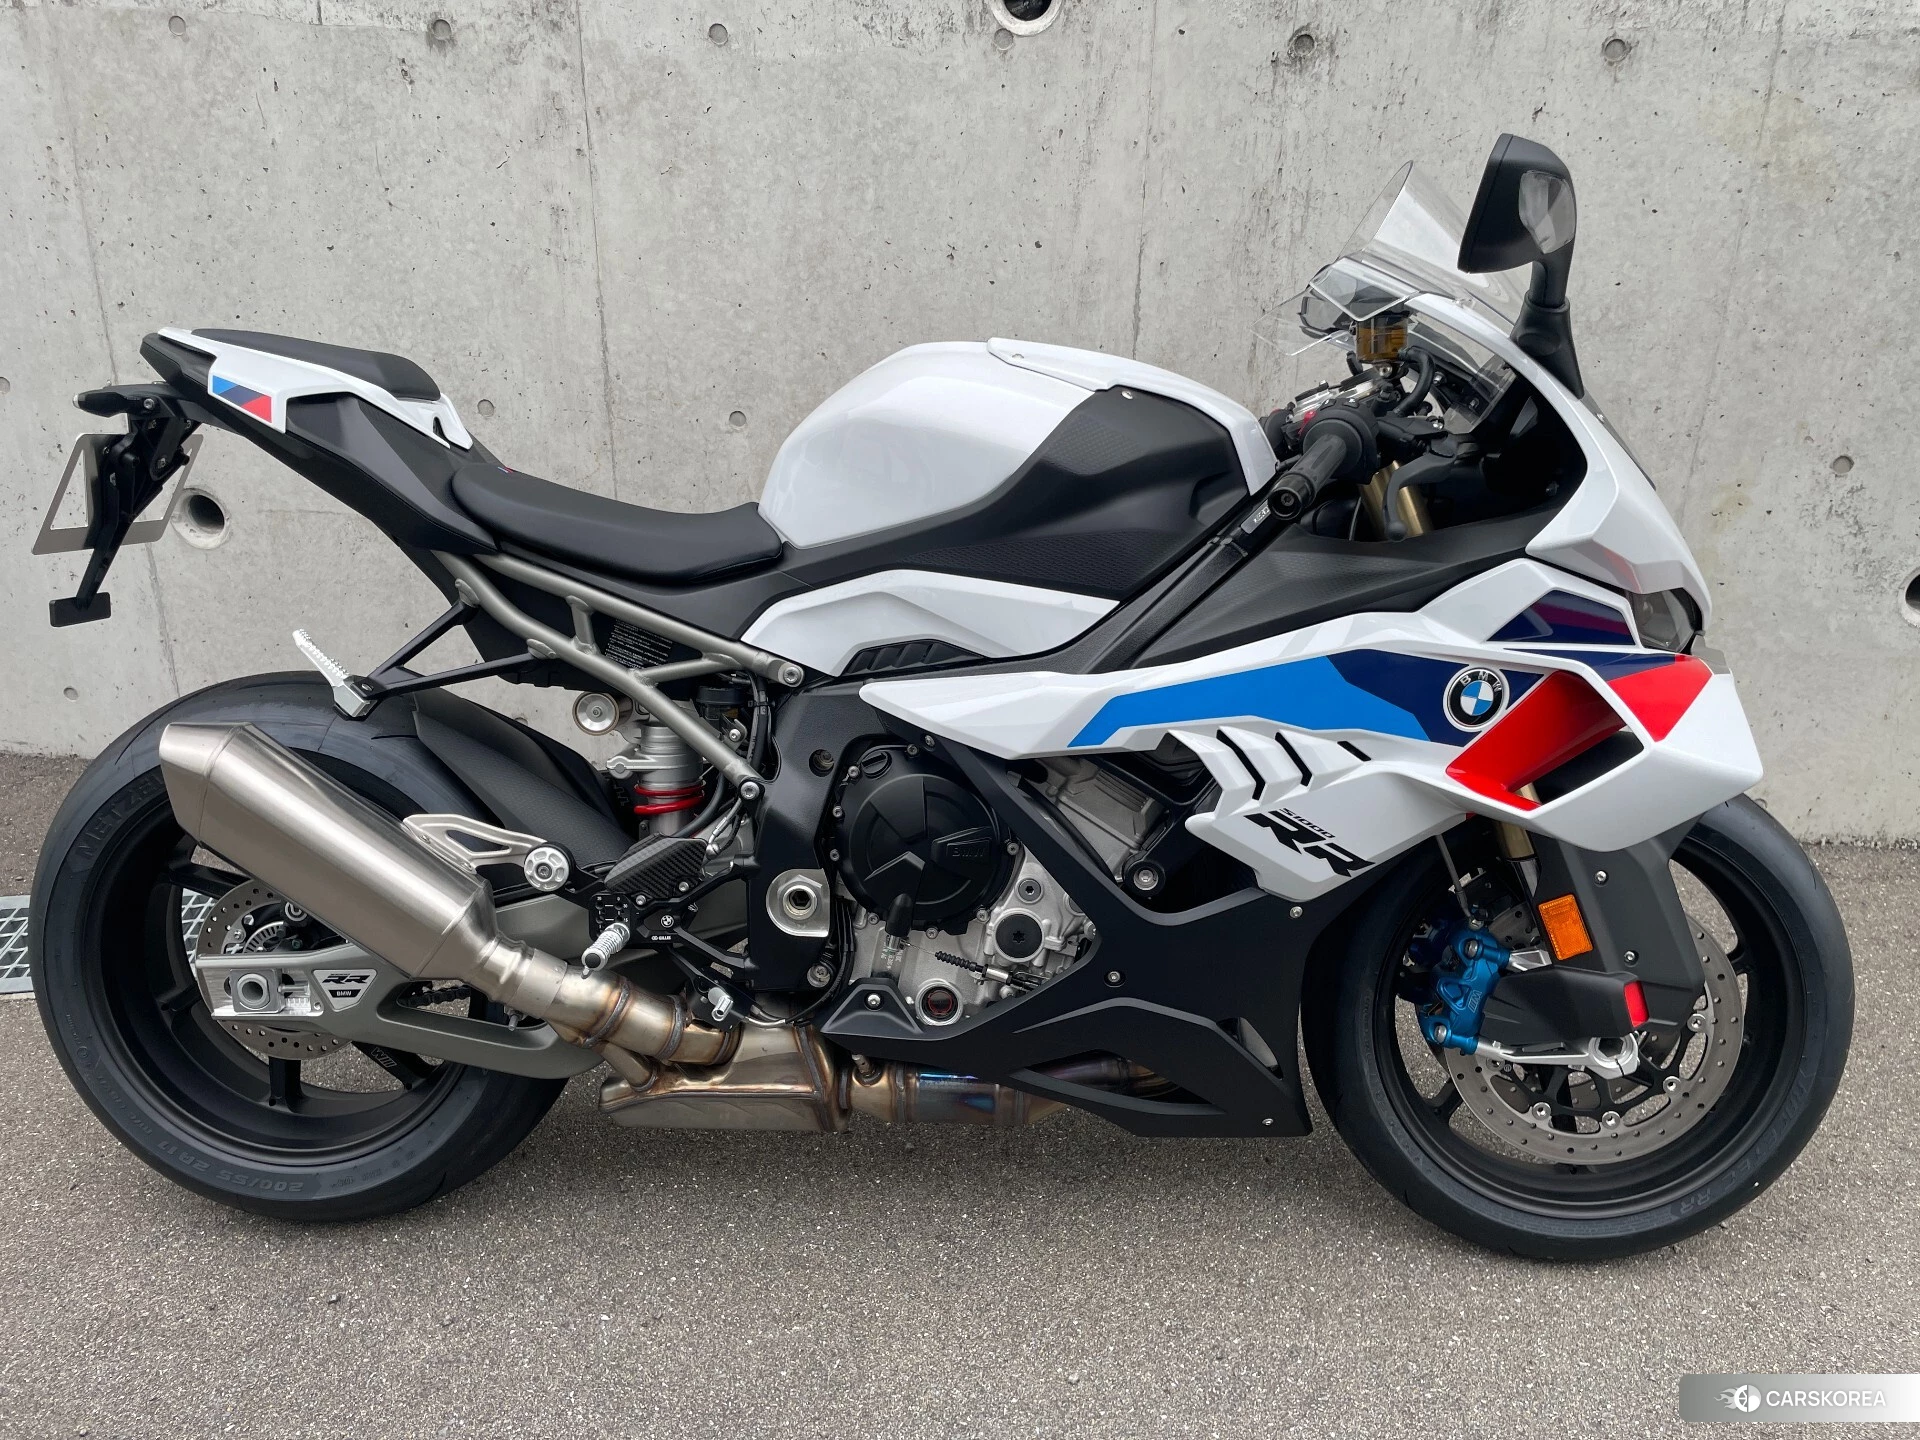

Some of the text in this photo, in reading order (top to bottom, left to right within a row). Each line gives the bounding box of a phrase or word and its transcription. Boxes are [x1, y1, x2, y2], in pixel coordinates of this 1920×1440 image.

[1460, 670, 1502, 692] BMW
[1279, 807, 1336, 839] S1000
[1243, 810, 1376, 877] RR
[321, 974, 371, 985] RR
[215, 1169, 304, 1192] 200/55
